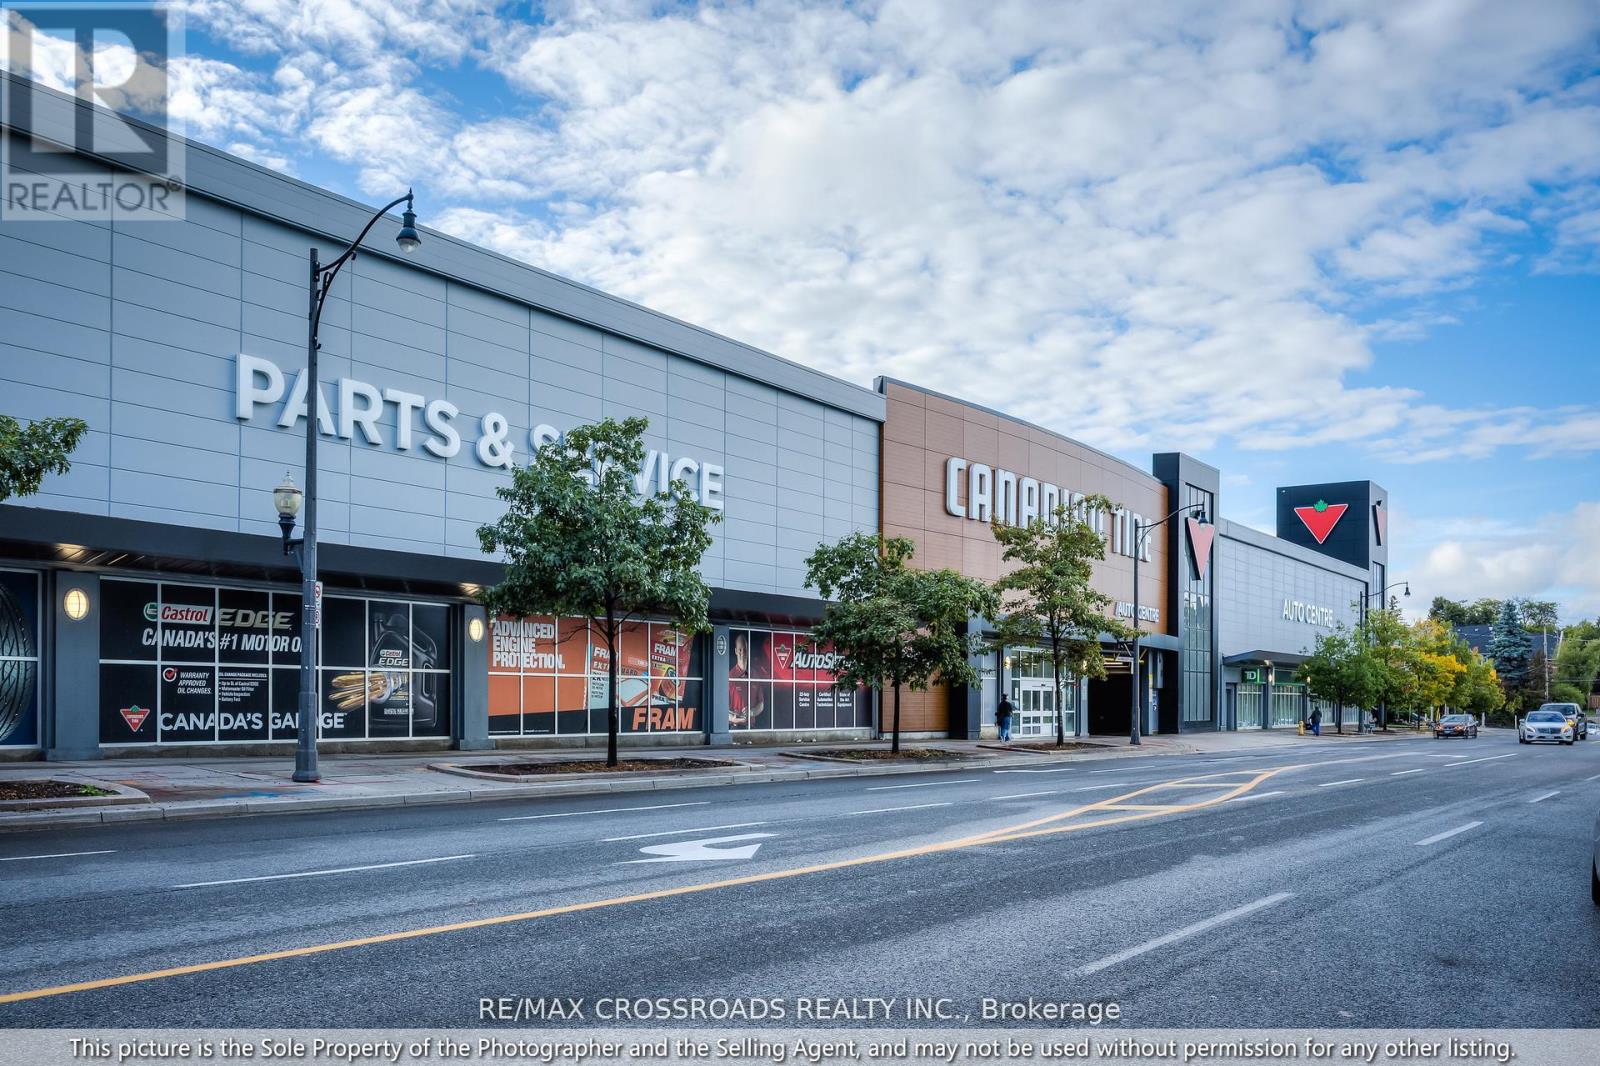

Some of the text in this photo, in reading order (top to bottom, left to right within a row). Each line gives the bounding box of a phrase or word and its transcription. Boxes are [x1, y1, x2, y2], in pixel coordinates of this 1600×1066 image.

[236, 354, 461, 458] PARTS
[475, 412, 515, 470] &
[161, 605, 208, 622] Castrol
[214, 608, 295, 630] EDGE
[1282, 599, 1333, 628] AUTO CENTRE
[492, 620, 555, 639] ADVANCED
[142, 628, 216, 649] CANADA'S
[220, 632, 237, 650] #1
[240, 634, 290, 652] MOTOR
[492, 636, 536, 654] ENGINE
[378, 658, 408, 666] EDGE
[492, 652, 566, 670] PROTECTION.
[1244, 671, 1256, 680] TD
[160, 712, 263, 731] CANADA'S
[632, 708, 695, 730] FRAM
